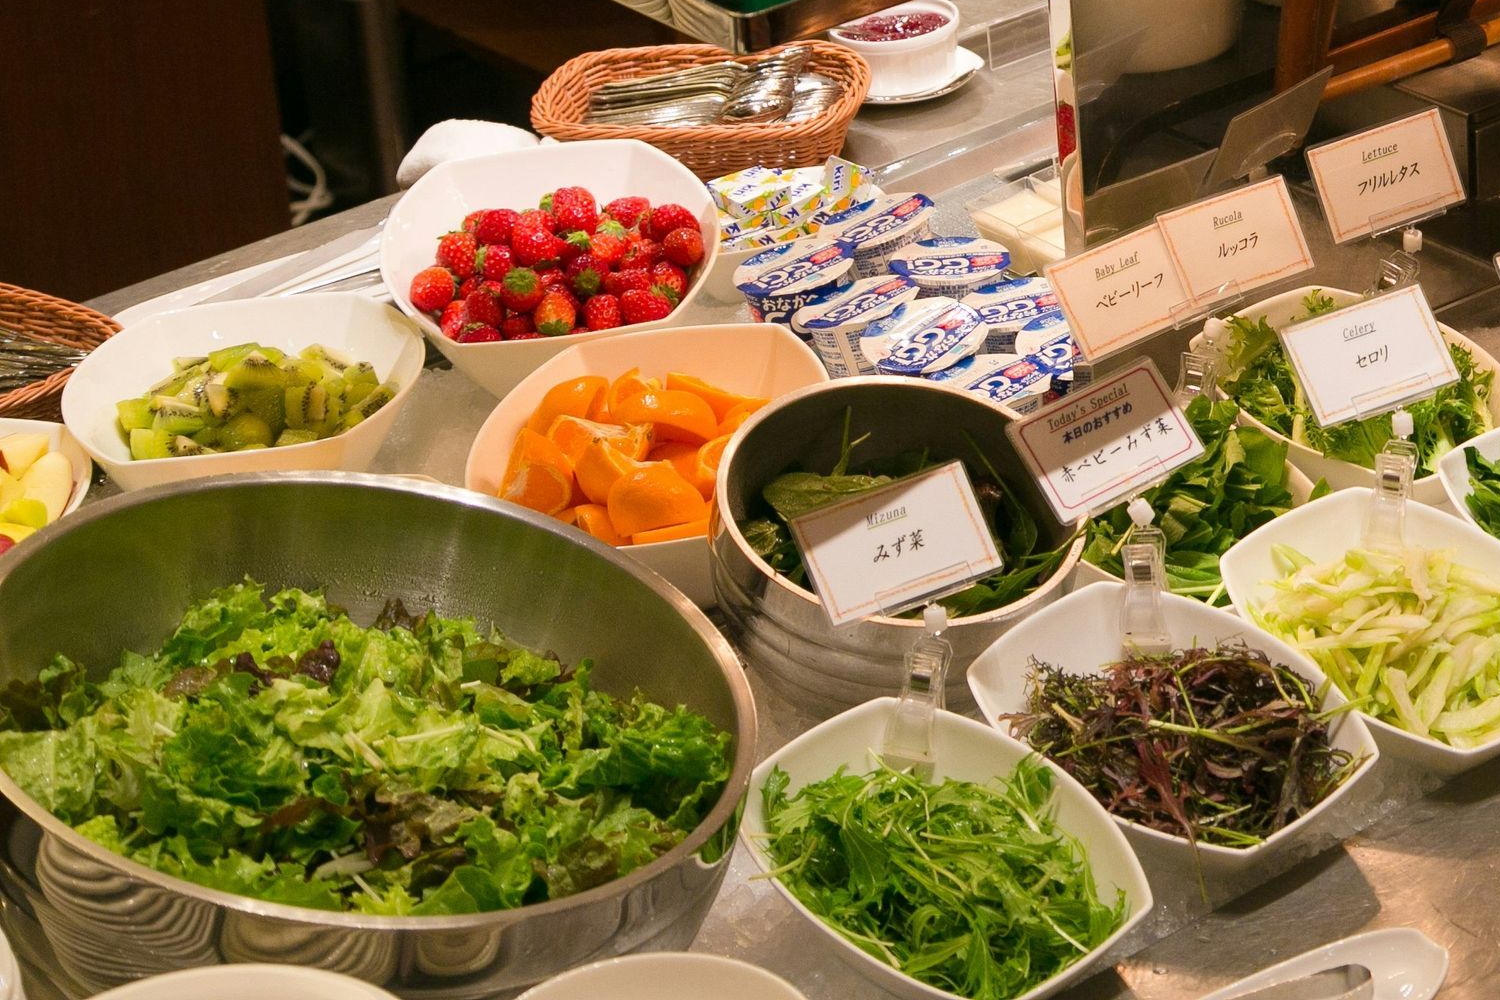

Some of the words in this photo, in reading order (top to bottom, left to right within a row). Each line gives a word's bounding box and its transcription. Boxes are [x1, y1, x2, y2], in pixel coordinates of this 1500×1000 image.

[1362, 143, 1398, 161] Lettuce
[732, 184, 758, 196] kiri
[833, 165, 844, 191] kiri
[1358, 162, 1420, 196] フリルレタス
[1213, 210, 1242, 227] Rucola
[1218, 231, 1258, 259] ルッコラ
[1095, 261, 1115, 279] Baby
[1120, 251, 1140, 268] Leaf
[762, 294, 818, 312] おなかへ
[1096, 273, 1164, 309] ベビーリーフ
[1342, 322, 1375, 340] Celery
[1356, 345, 1388, 368] セロリ
[1047, 405, 1086, 431] Today's
[1090, 383, 1128, 409] Special
[1063, 402, 1133, 444] 本日のおすすめ
[866, 506, 907, 527] Mizuna
[873, 529, 925, 563] みず菜
